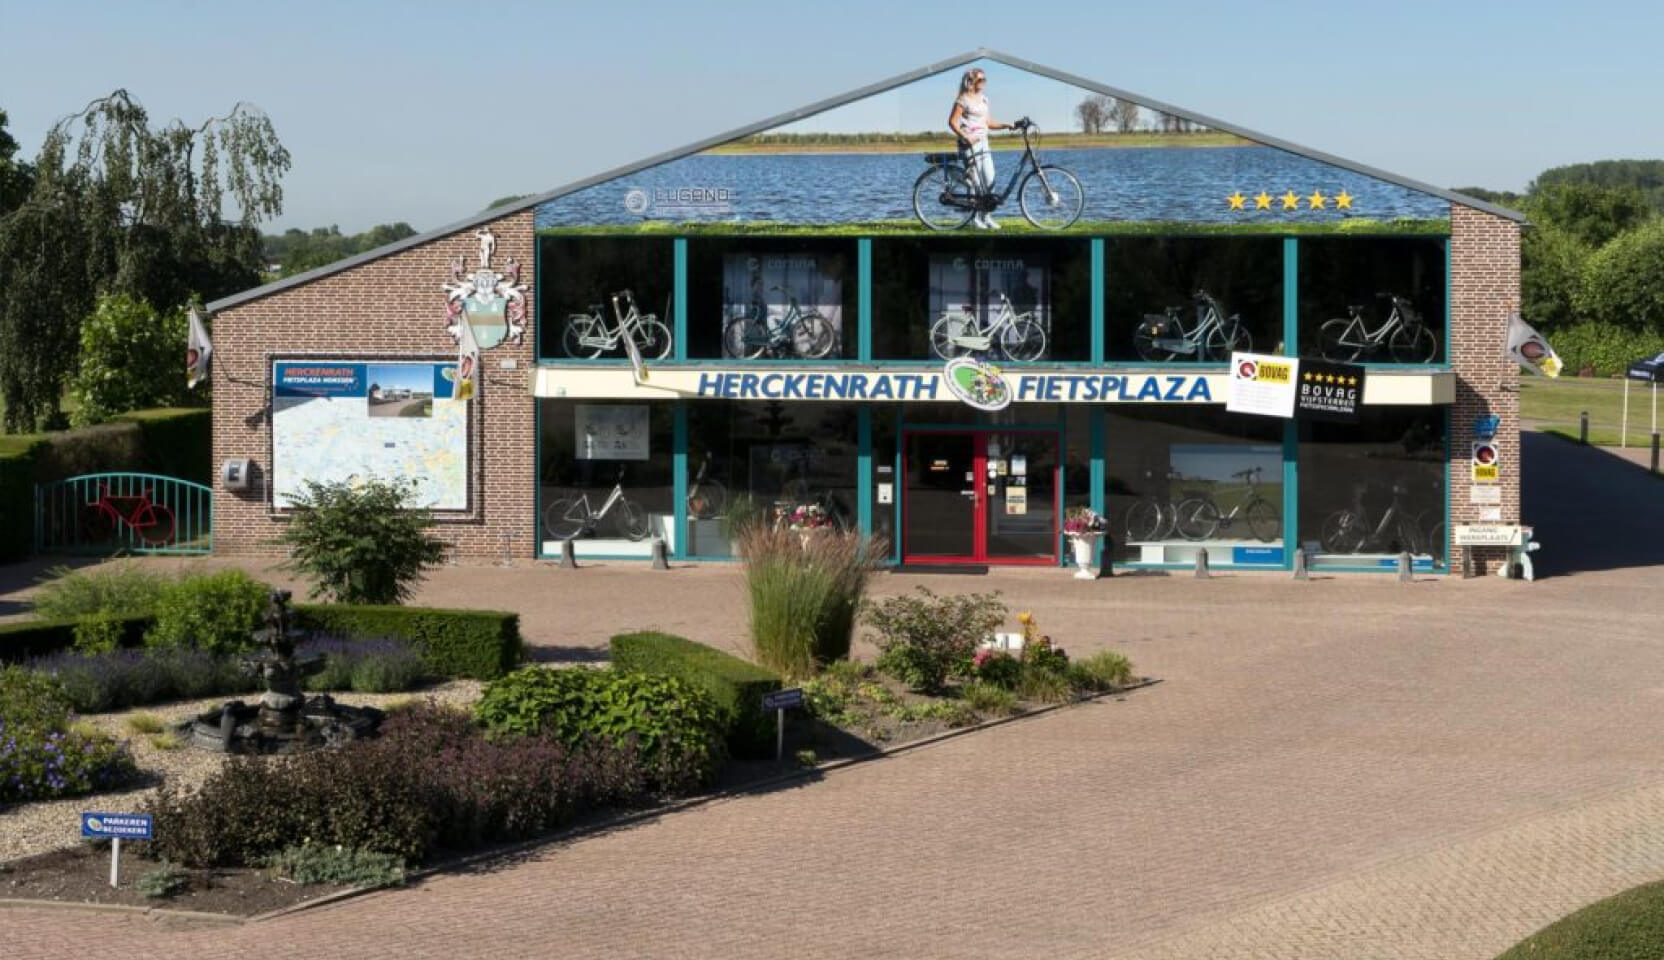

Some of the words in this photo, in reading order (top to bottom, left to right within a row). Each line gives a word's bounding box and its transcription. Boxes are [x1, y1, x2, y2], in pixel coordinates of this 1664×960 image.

[1259, 364, 1289, 381] BOVAG
[698, 372, 939, 399] HERCKENRATH
[1018, 375, 1212, 401] FIETSPLAZA
[1301, 383, 1356, 399] BOVAG
[103, 817, 147, 827] PARKEREN
[103, 827, 147, 835] BEZOEKERS
